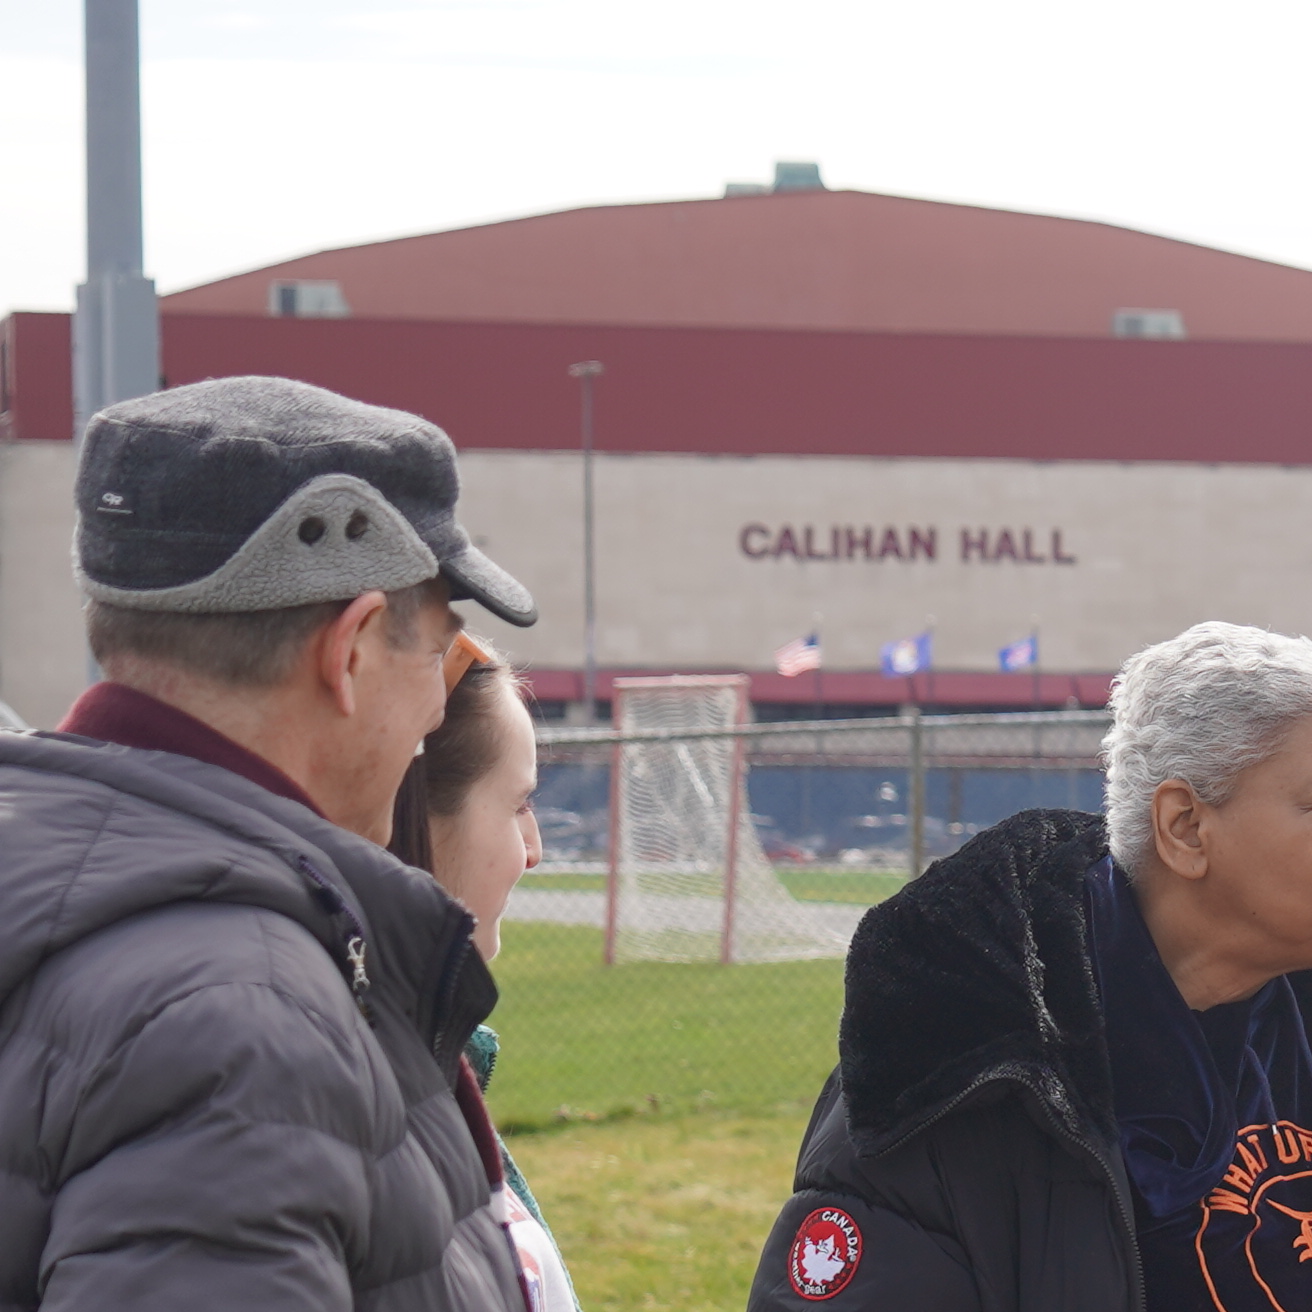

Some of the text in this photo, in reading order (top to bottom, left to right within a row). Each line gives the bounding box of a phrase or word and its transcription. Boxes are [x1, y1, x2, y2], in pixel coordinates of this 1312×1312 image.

[739, 524, 1077, 565] CALIHAN HALL
[1208, 1134, 1268, 1215] WHAT
[821, 1210, 859, 1259] CANADA
